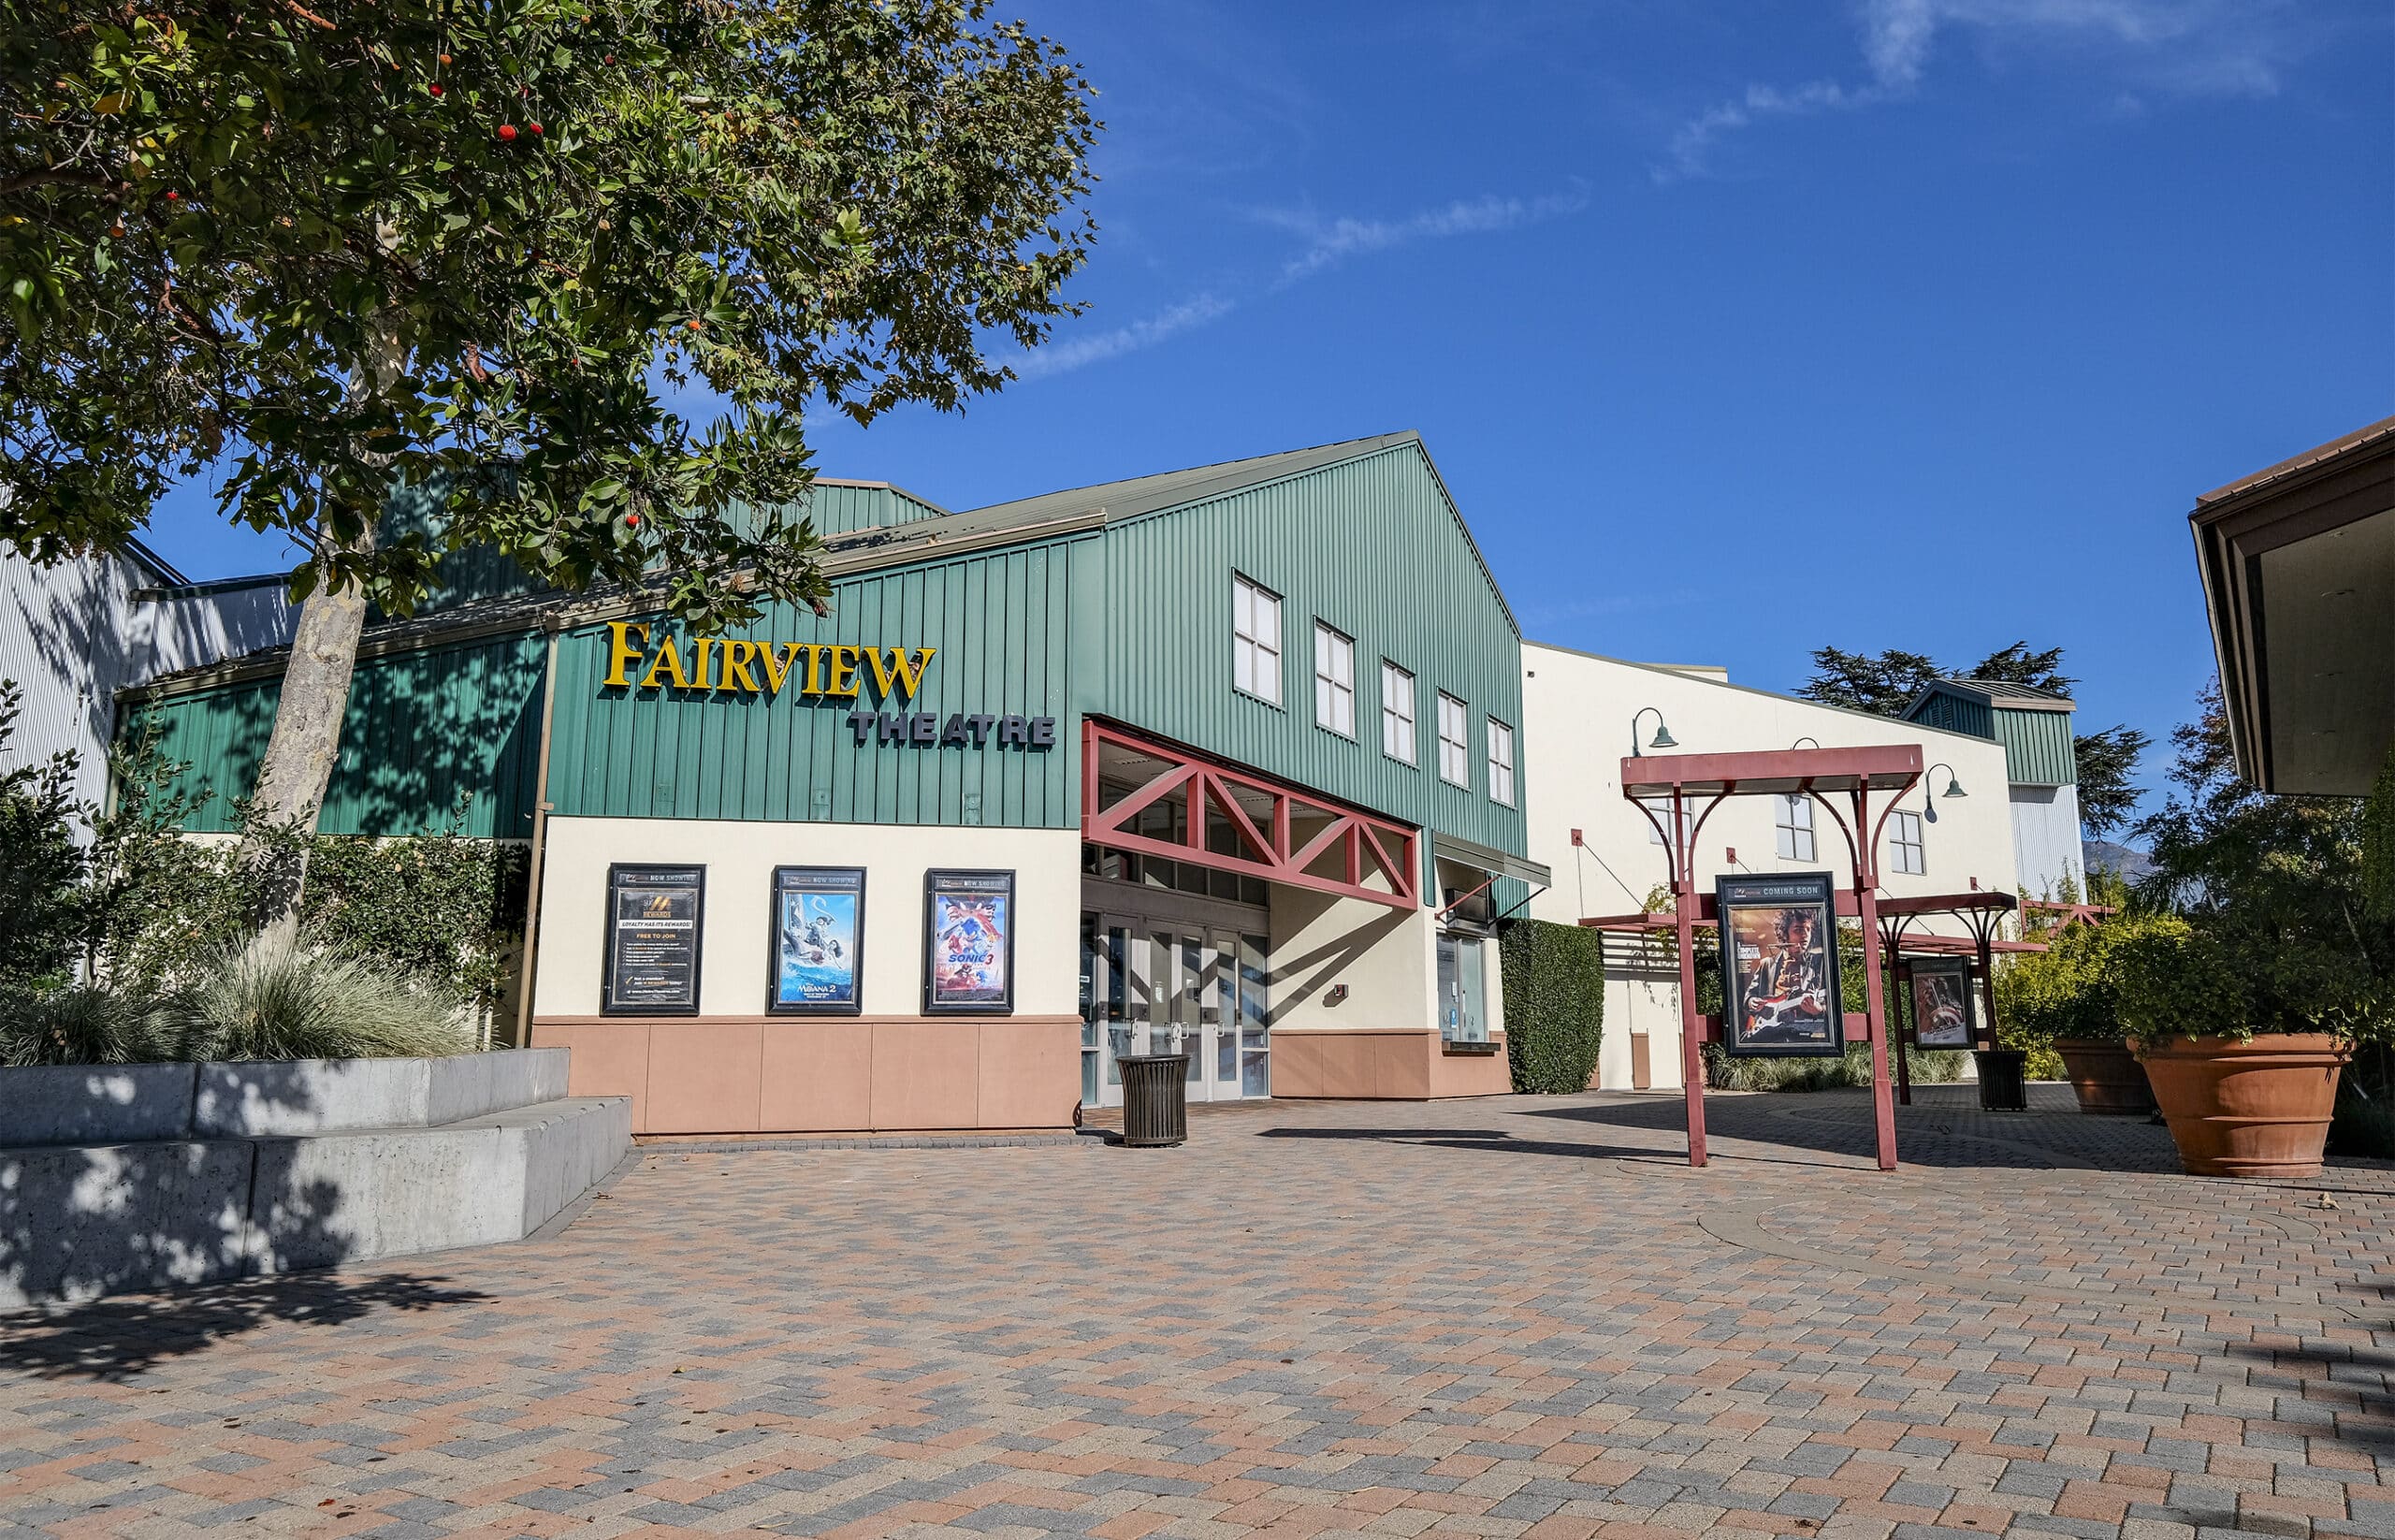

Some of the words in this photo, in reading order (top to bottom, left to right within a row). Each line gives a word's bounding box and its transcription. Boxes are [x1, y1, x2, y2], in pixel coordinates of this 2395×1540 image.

[603, 621, 936, 699] FAIRVIEW
[849, 711, 1056, 746] THEATRE
[1763, 886, 1794, 895] COMING
[1796, 886, 1818, 894] SOON
[948, 953, 987, 963] SONIC
[985, 953, 994, 965] 3
[797, 984, 829, 993] MOANA
[829, 984, 837, 993] 2
